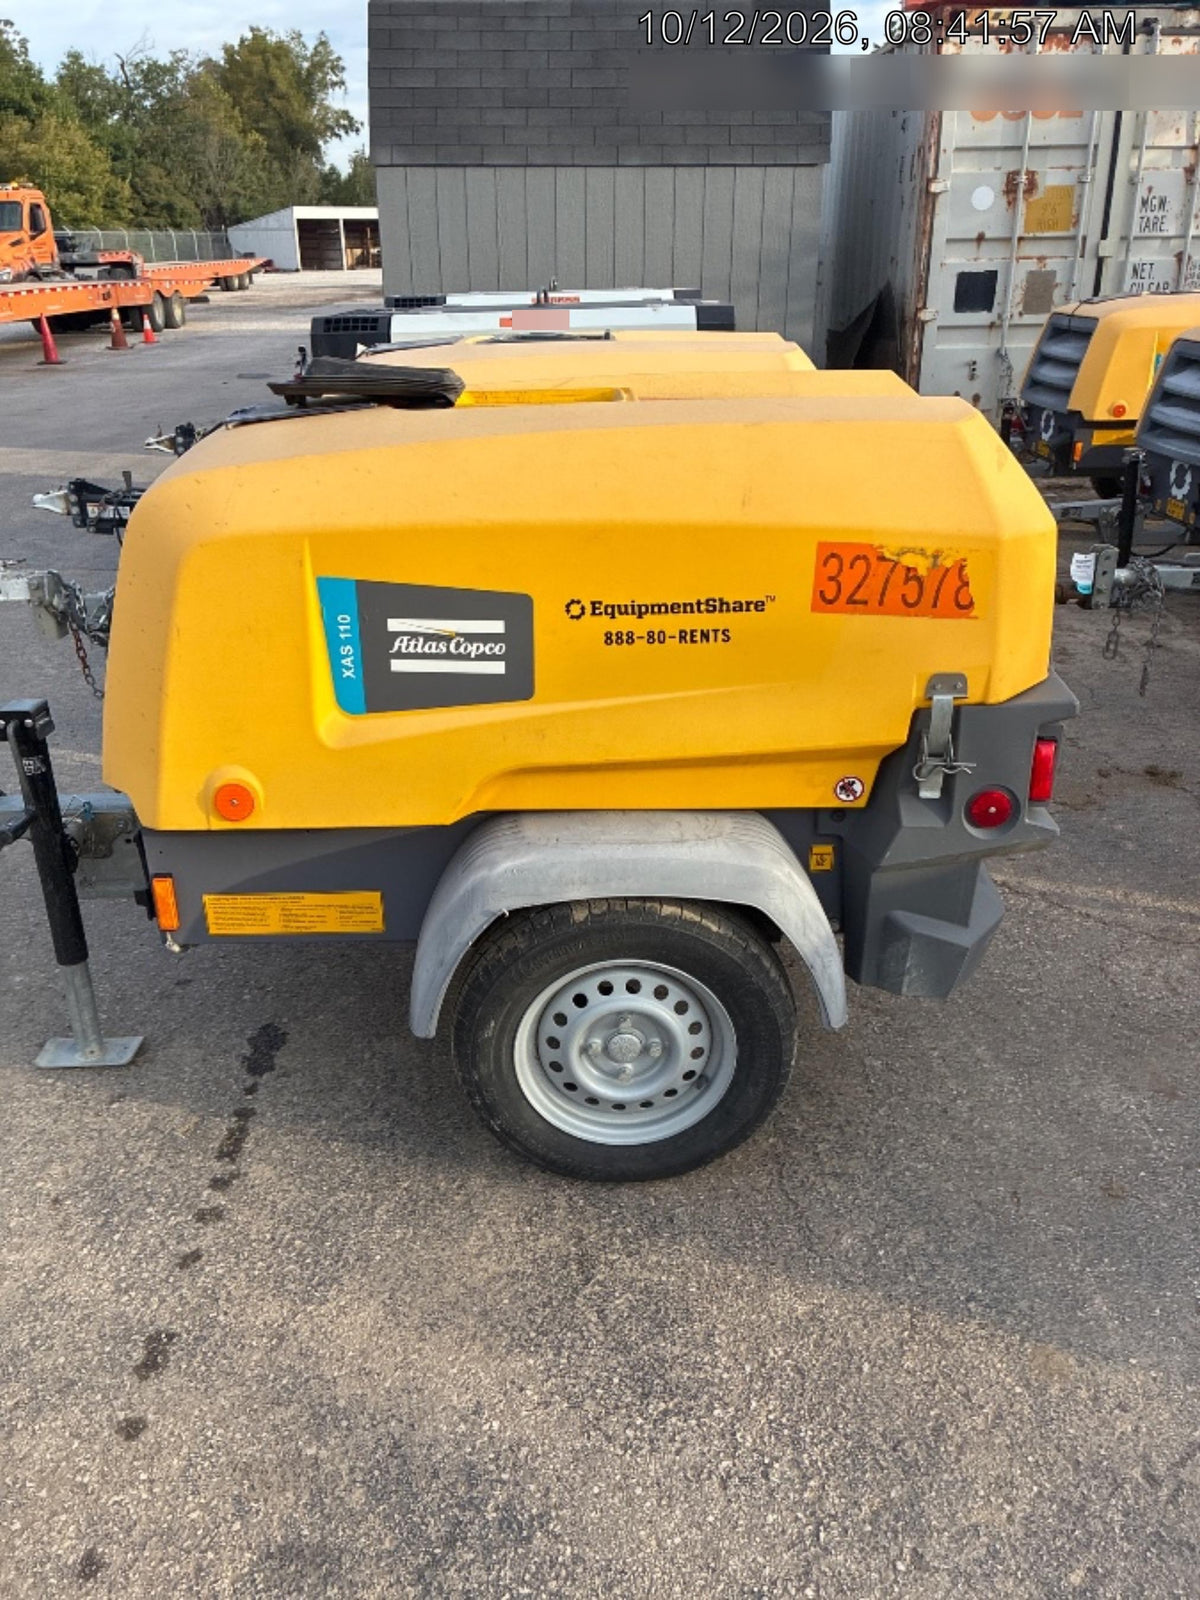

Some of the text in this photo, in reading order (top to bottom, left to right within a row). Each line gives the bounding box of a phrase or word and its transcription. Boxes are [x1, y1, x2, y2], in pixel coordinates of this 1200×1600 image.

[336, 613, 356, 679] XAS 110
[389, 635, 506, 659] Atlas Copco
[603, 628, 732, 646] 888-80-RENTS
